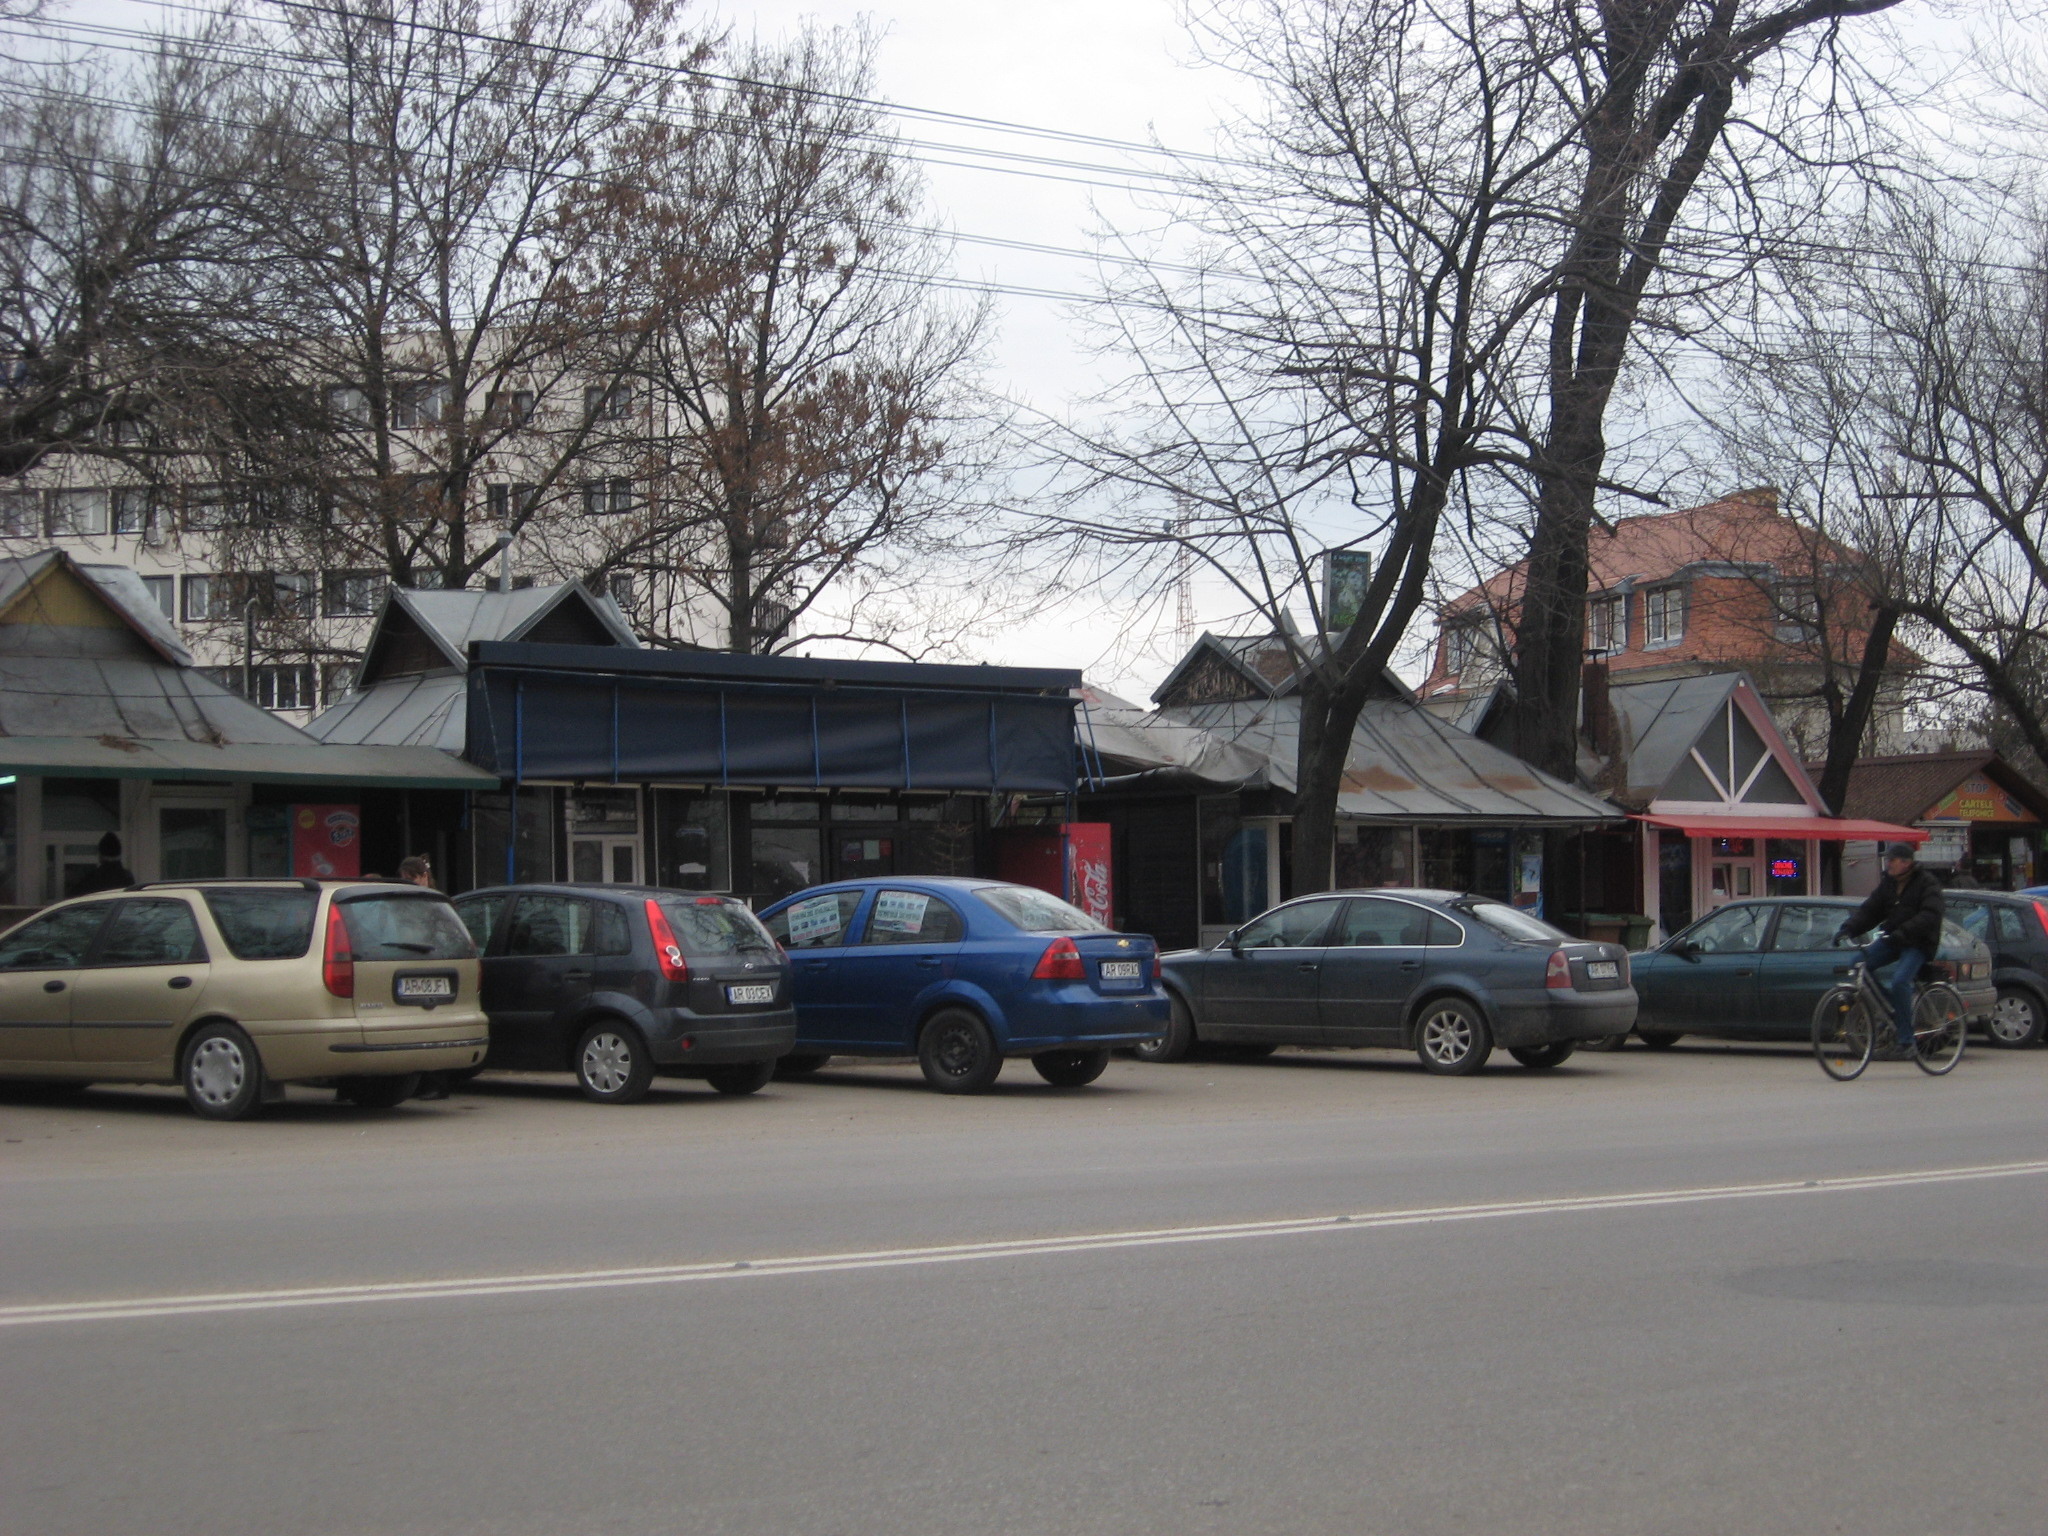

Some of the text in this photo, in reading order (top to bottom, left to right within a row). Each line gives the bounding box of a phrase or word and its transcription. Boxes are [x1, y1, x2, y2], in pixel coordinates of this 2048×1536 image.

[1964, 783, 1990, 793] STOP
[1959, 799, 1993, 808] CARTELE
[403, 979, 418, 993] AR
[733, 987, 745, 1001] AR
